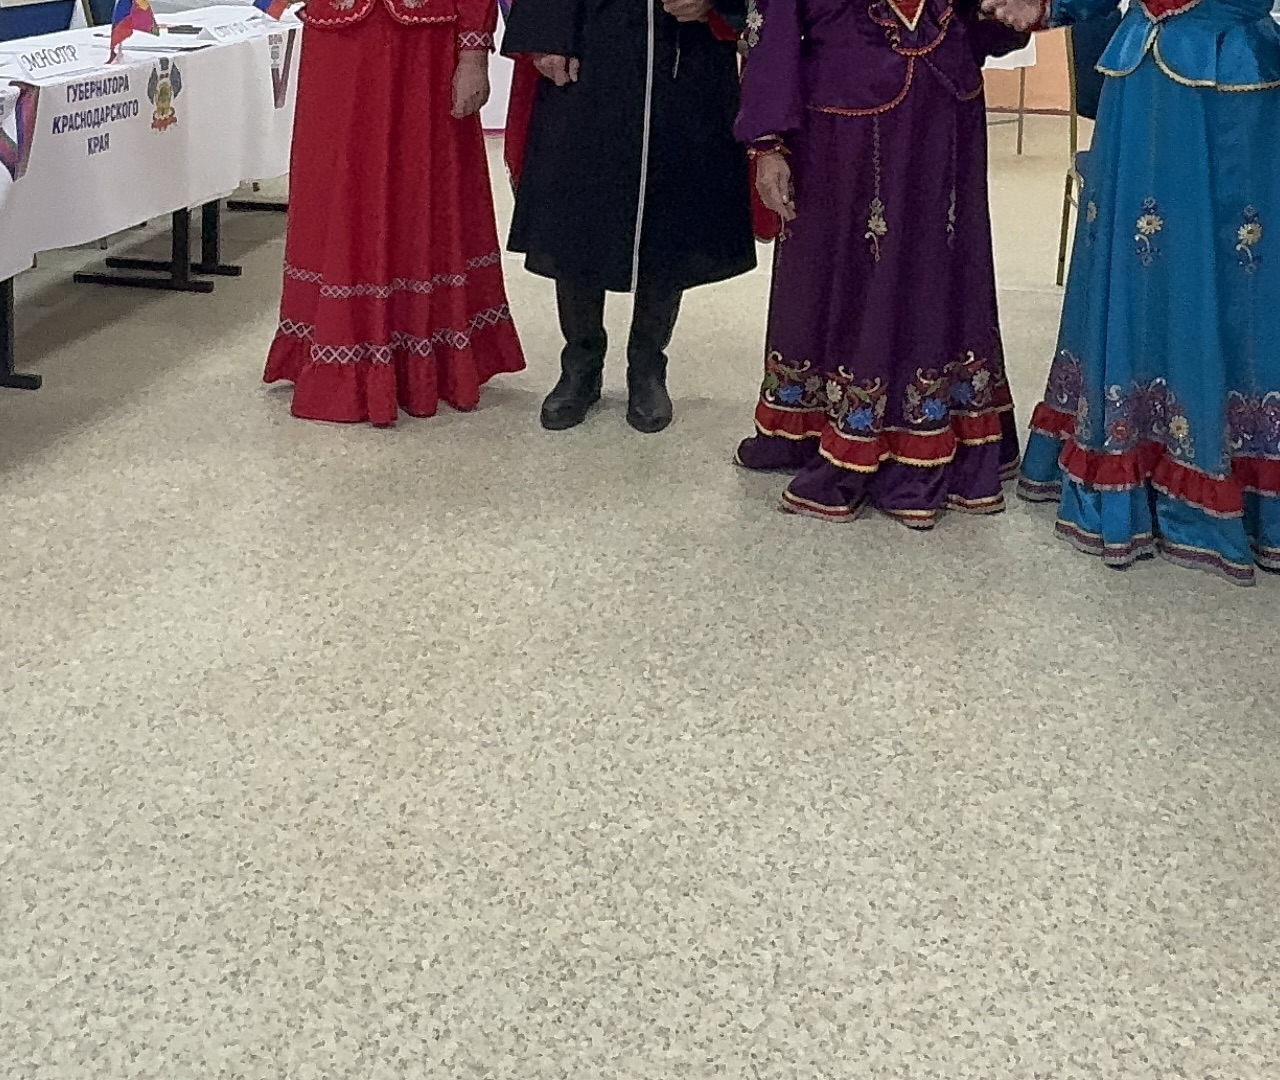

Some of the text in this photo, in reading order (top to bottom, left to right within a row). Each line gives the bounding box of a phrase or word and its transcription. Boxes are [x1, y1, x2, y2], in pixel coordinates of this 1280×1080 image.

[66, 73, 130, 103] ГУБЕРНАТОРА
[52, 99, 139, 134] КРАСНОДАРСКОГО
[87, 132, 110, 156] КРАЯ
